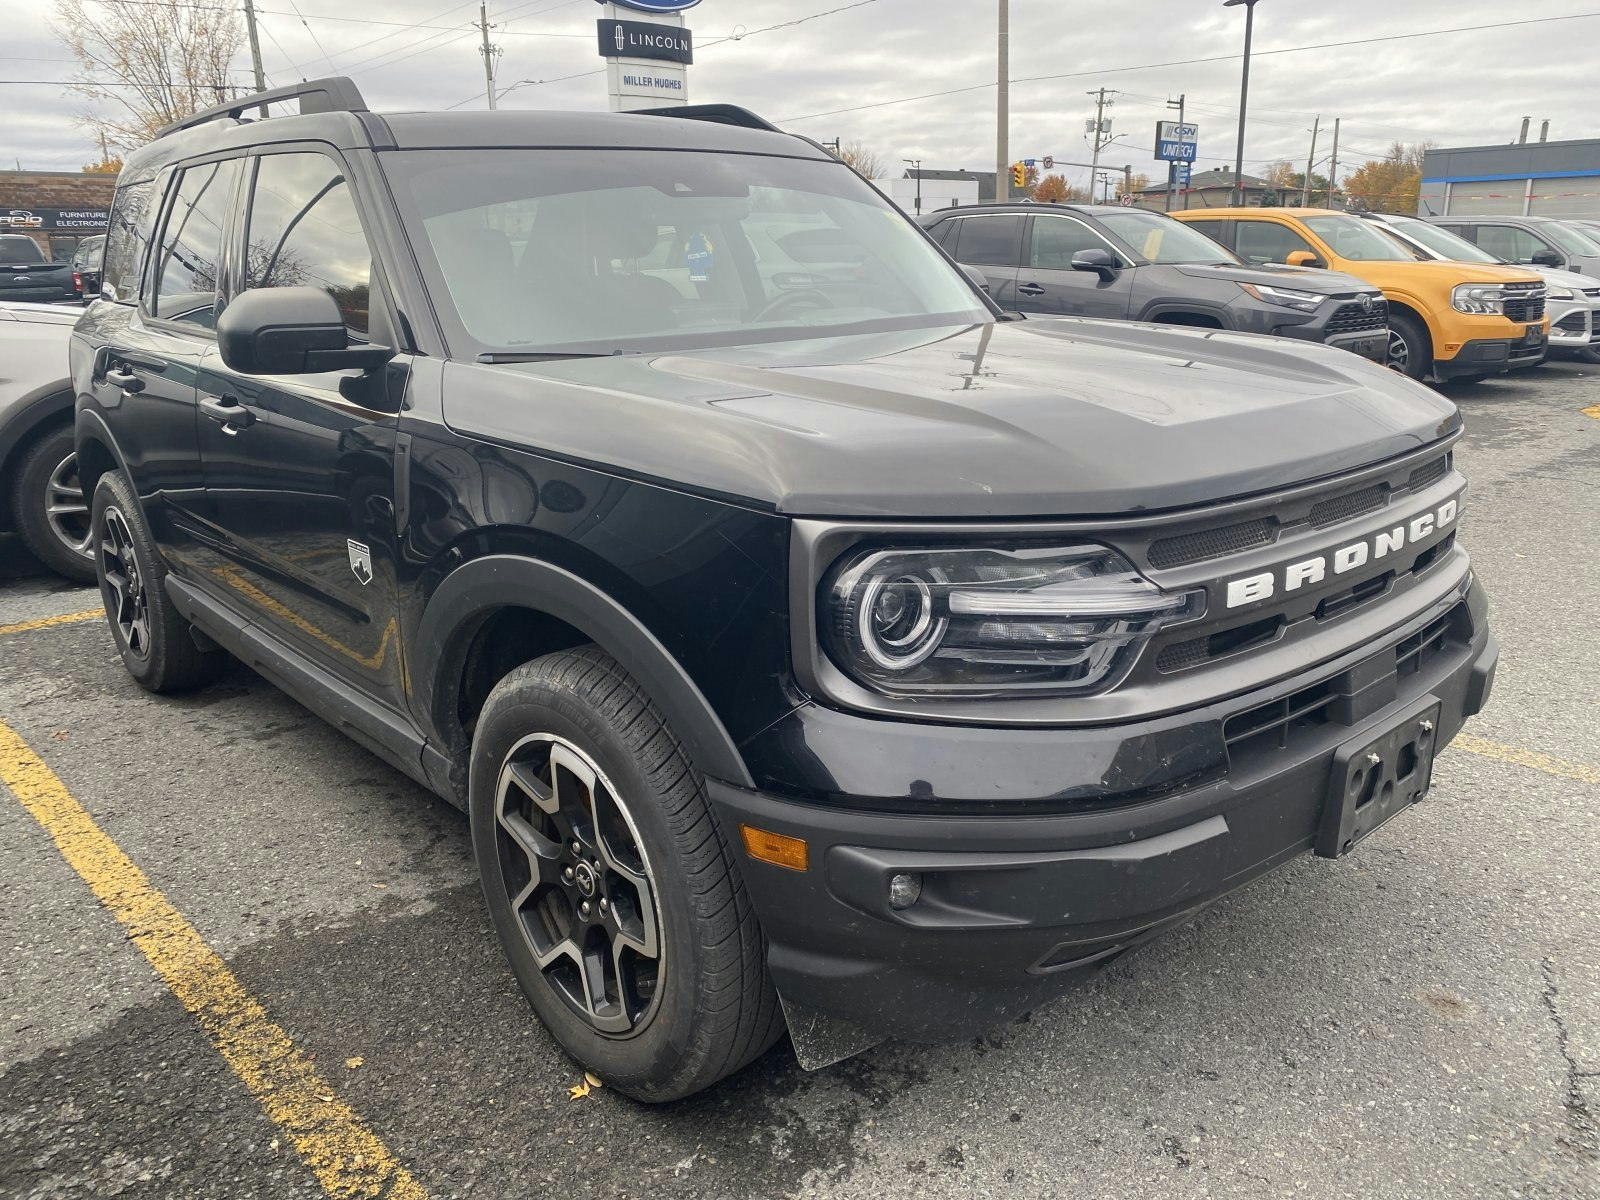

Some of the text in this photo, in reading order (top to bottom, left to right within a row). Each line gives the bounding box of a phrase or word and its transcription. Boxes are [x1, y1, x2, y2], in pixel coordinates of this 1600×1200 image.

[630, 32, 688, 51] LINCOLN
[623, 75, 682, 90] MILLER HUGHES
[1174, 126, 1196, 136] CSN
[59, 211, 108, 219] FURNITURE
[1226, 499, 1457, 609] BRONCO
